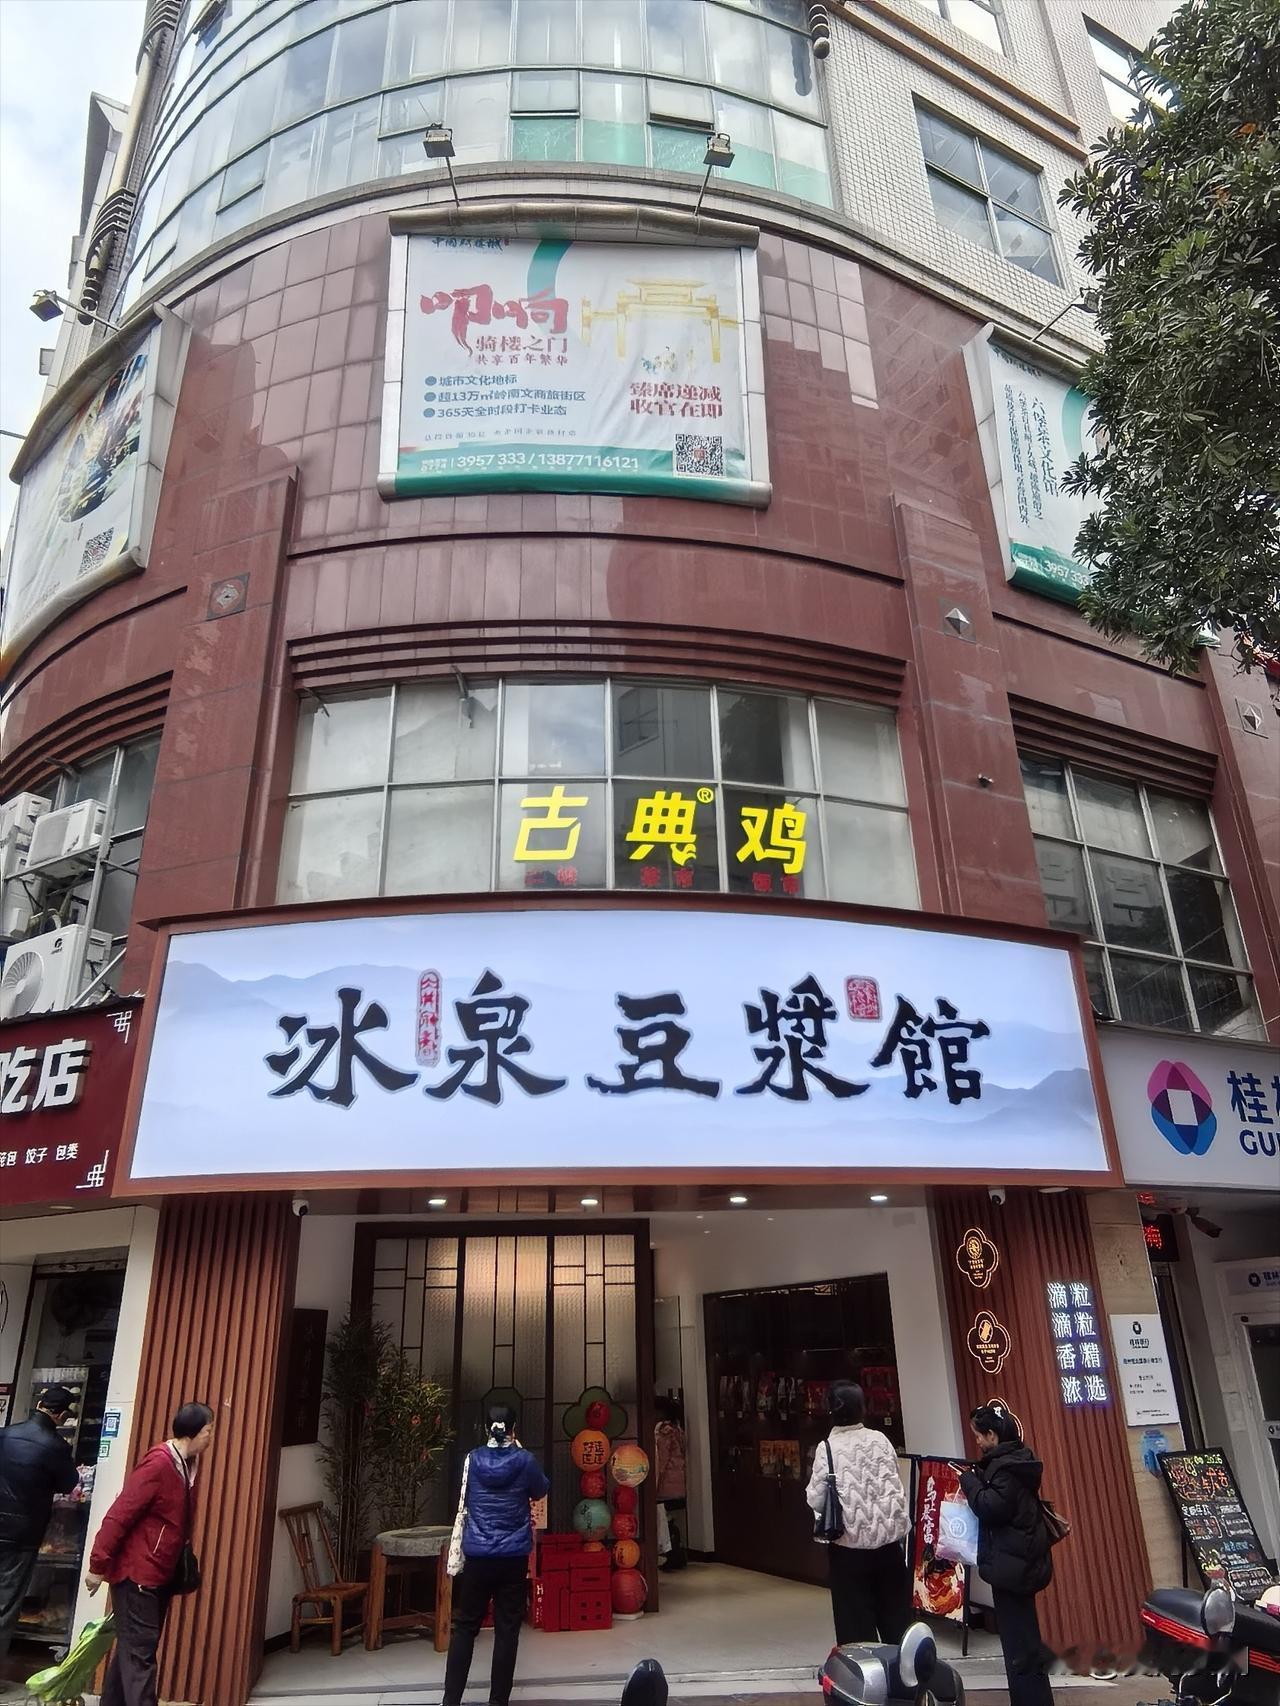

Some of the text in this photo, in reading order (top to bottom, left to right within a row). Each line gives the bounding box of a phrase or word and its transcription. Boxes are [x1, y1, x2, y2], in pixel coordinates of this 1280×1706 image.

[475, 335, 567, 353] 骑楼之门
[476, 353, 568, 366] 共享百年繁华
[438, 375, 517, 387] 城市文化地标
[630, 382, 722, 402] 臻席递减
[437, 404, 567, 418] 365天全时段打卡业态
[630, 399, 723, 419] 收官在即
[513, 786, 807, 874] 古典鸡
[265, 968, 990, 1108] 冰泉豆漿館
[1240, 1129, 1280, 1156] GU
[25, 1147, 48, 1164] 饺子
[1047, 1282, 1082, 1404] 滴滴香浓
[1069, 1282, 1107, 1402] 粒粒精选
